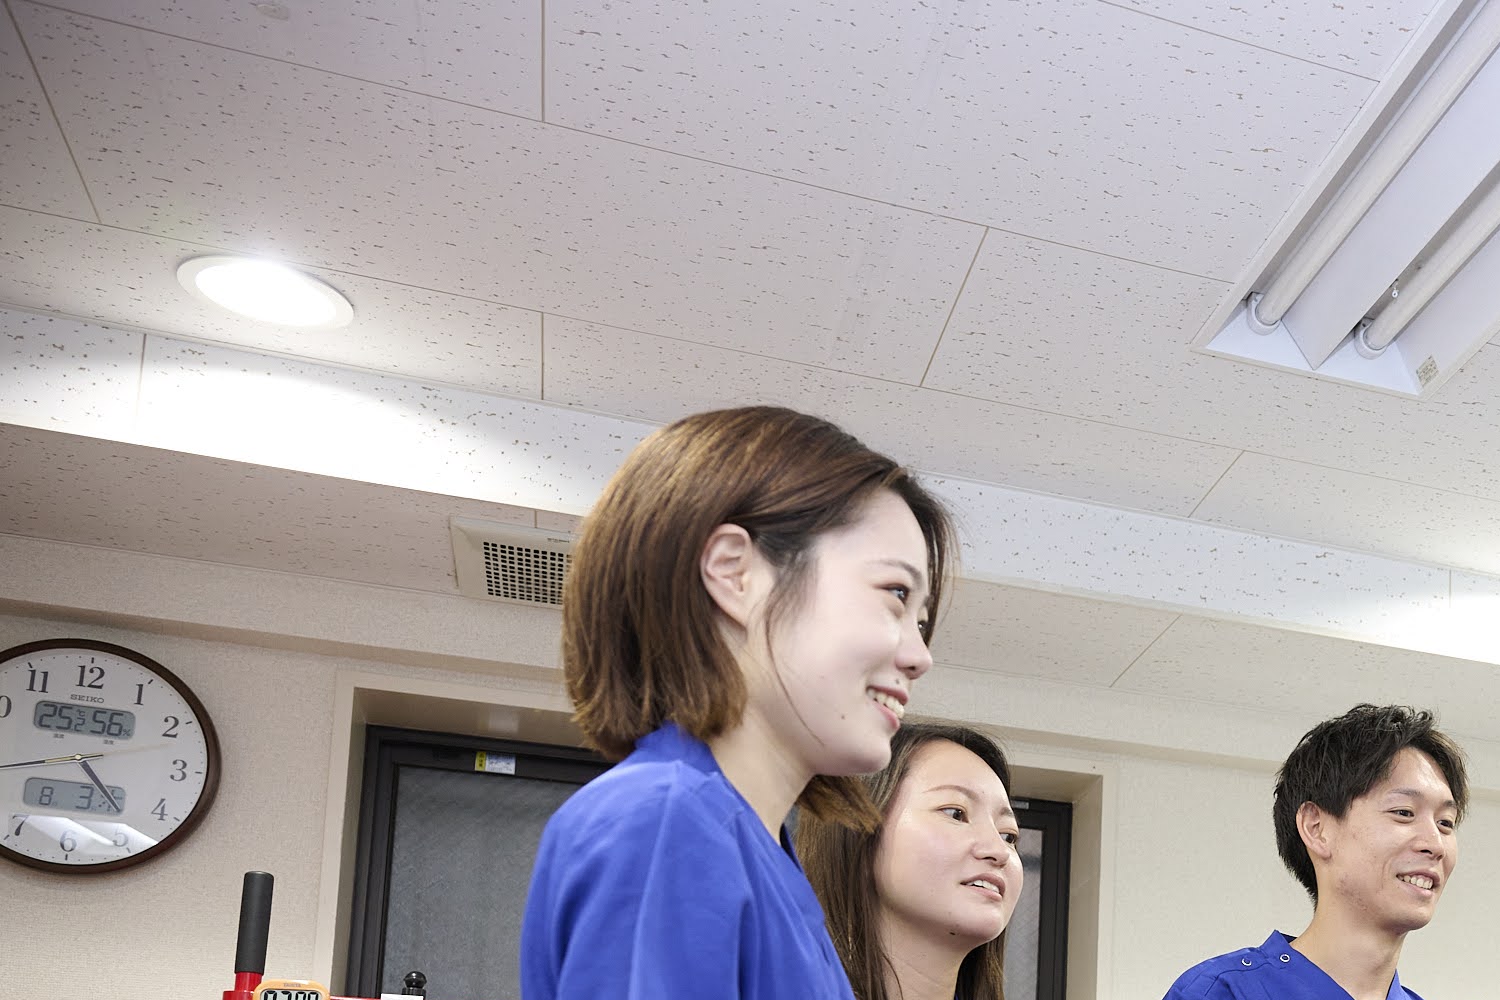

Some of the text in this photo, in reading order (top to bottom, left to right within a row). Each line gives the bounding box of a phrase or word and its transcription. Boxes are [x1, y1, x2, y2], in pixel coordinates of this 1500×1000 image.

[25, 669, 49, 693] 11
[75, 665, 105, 690] 12
[70, 694, 105, 704] SEIKO
[134, 683, 144, 706] 1
[162, 715, 180, 738] 2
[169, 759, 187, 781] 3
[151, 798, 168, 821] 4
[12, 813, 30, 836] 7
[60, 829, 77, 852] 6
[112, 826, 129, 847] 5
